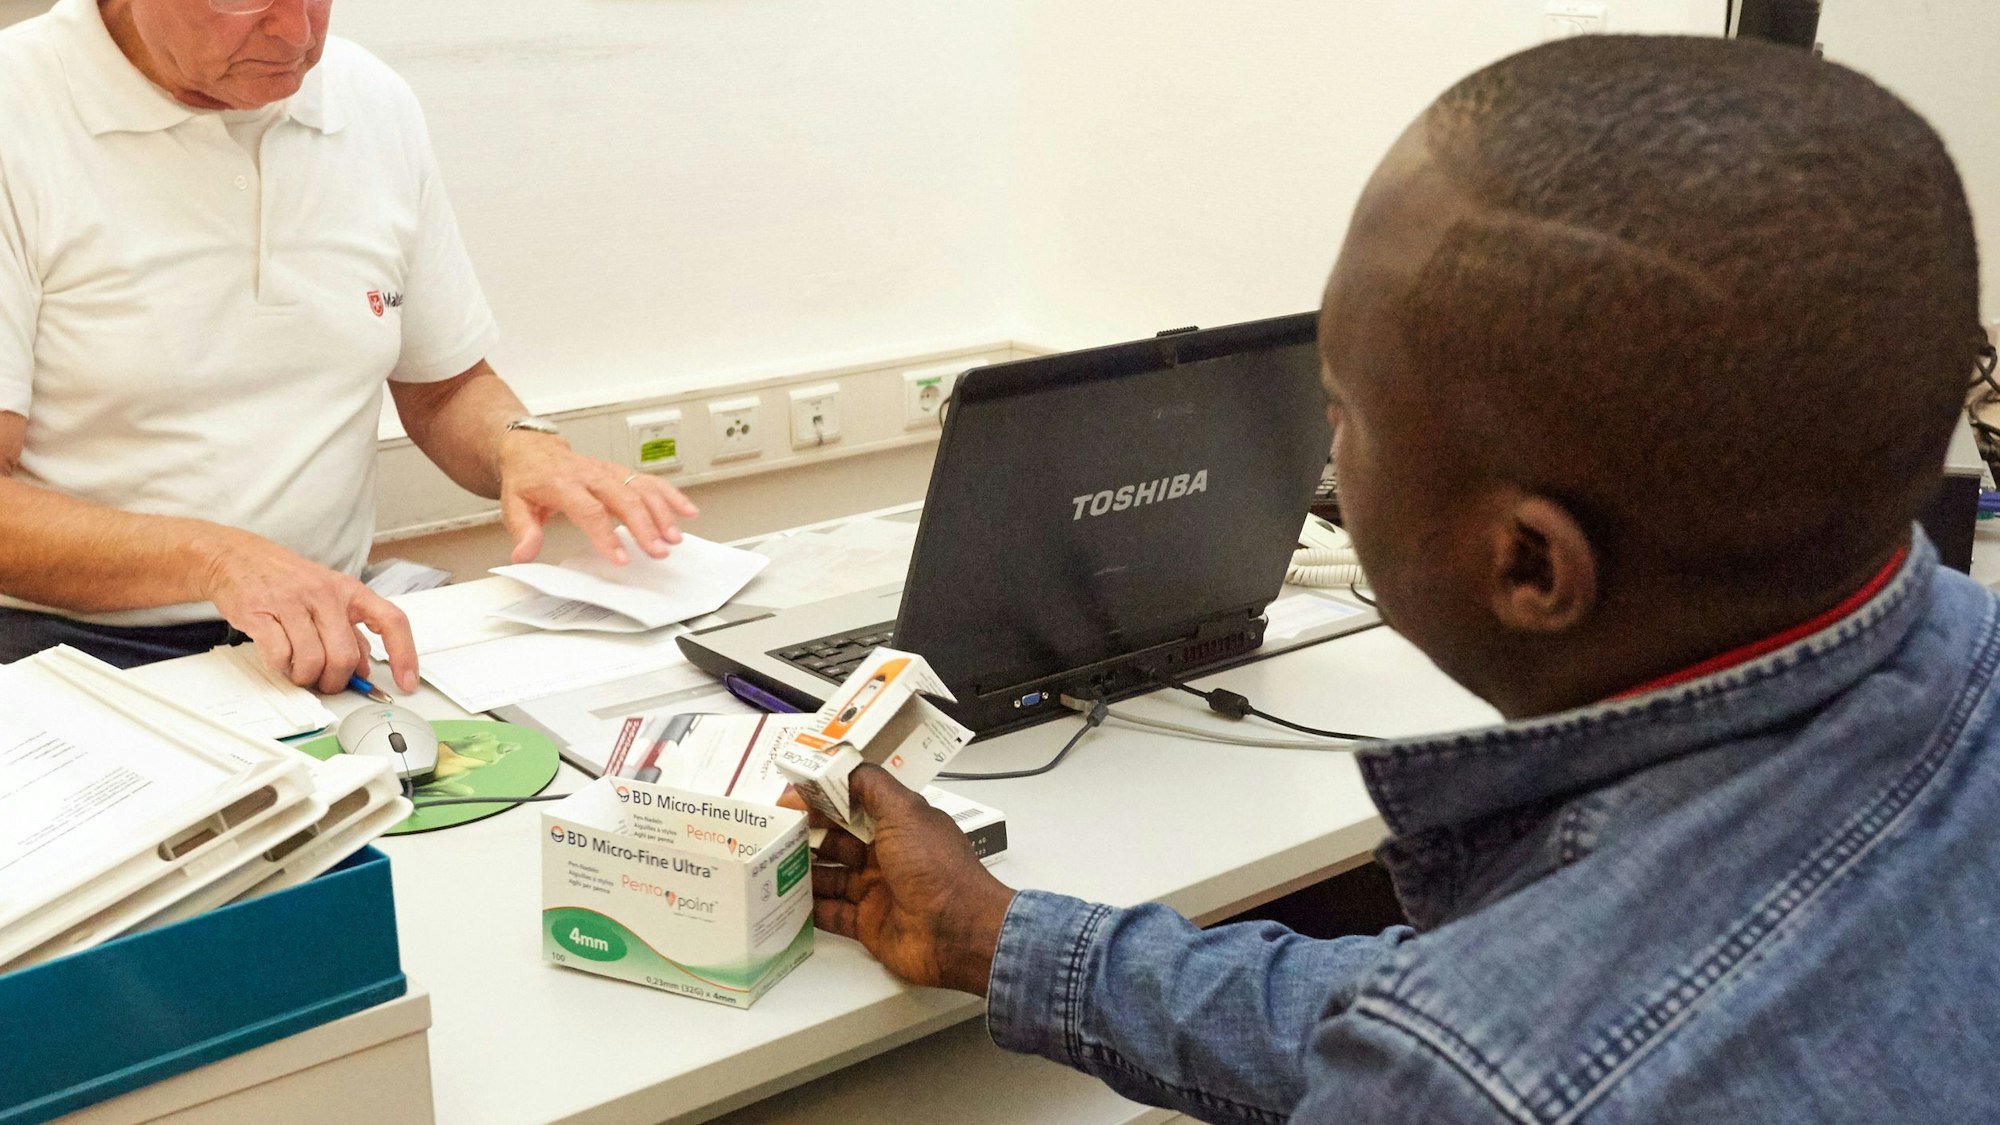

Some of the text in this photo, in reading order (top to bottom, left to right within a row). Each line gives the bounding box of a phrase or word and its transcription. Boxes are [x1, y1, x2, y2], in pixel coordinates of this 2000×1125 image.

[1072, 469, 1208, 521] TOSHIBA
[632, 790, 652, 806] BD
[657, 794, 731, 821] Micro-Fine
[687, 824, 726, 845] Penta
[567, 831, 587, 848] BD
[592, 838, 669, 869] Micro-Fine
[621, 874, 664, 897] Penta
[569, 927, 609, 952] 4mm
[552, 952, 566, 962] 100
[681, 983, 704, 998] (32G)
[713, 992, 737, 1004] 4mm
